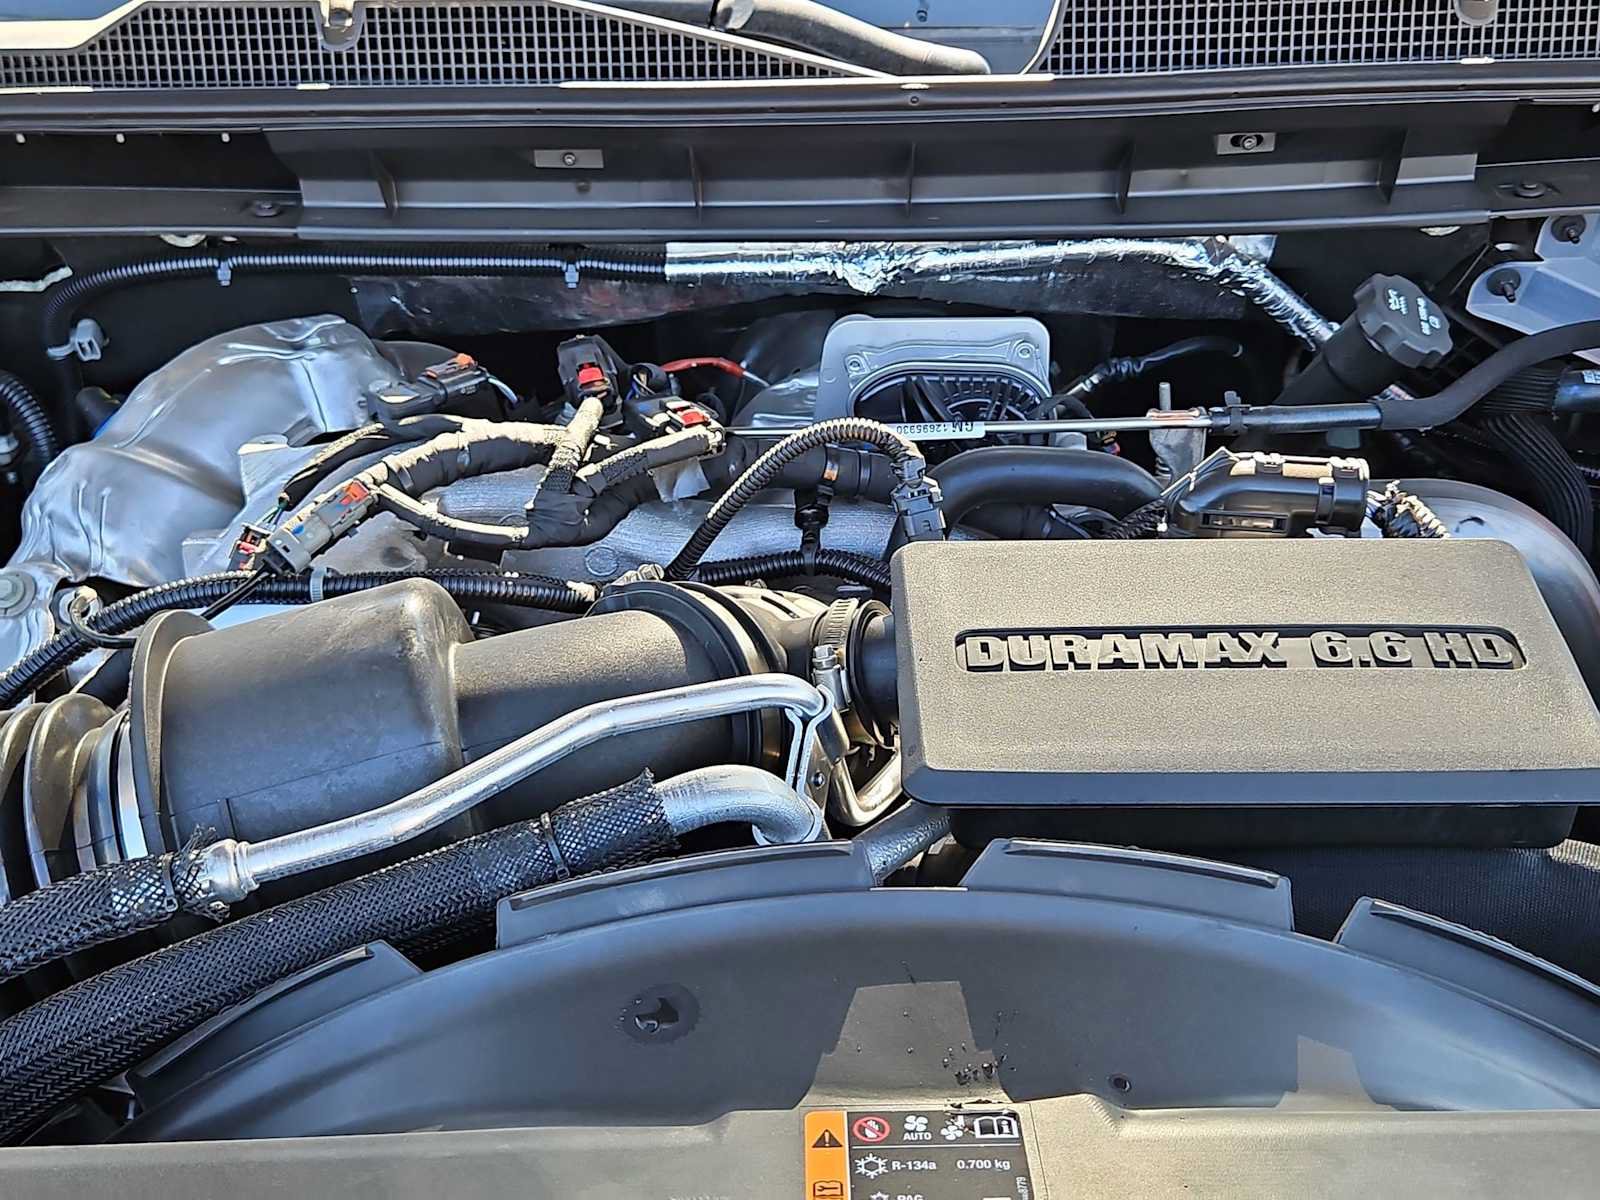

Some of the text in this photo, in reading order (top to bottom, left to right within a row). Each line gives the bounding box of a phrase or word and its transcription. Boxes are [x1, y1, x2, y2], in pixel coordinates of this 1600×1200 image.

[951, 421, 974, 433] GM
[965, 631, 1514, 670] DURAMAX 6.6 HD
[903, 1131, 932, 1141] AUTO
[891, 1159, 1011, 1171] R-134a 0.700 kg
